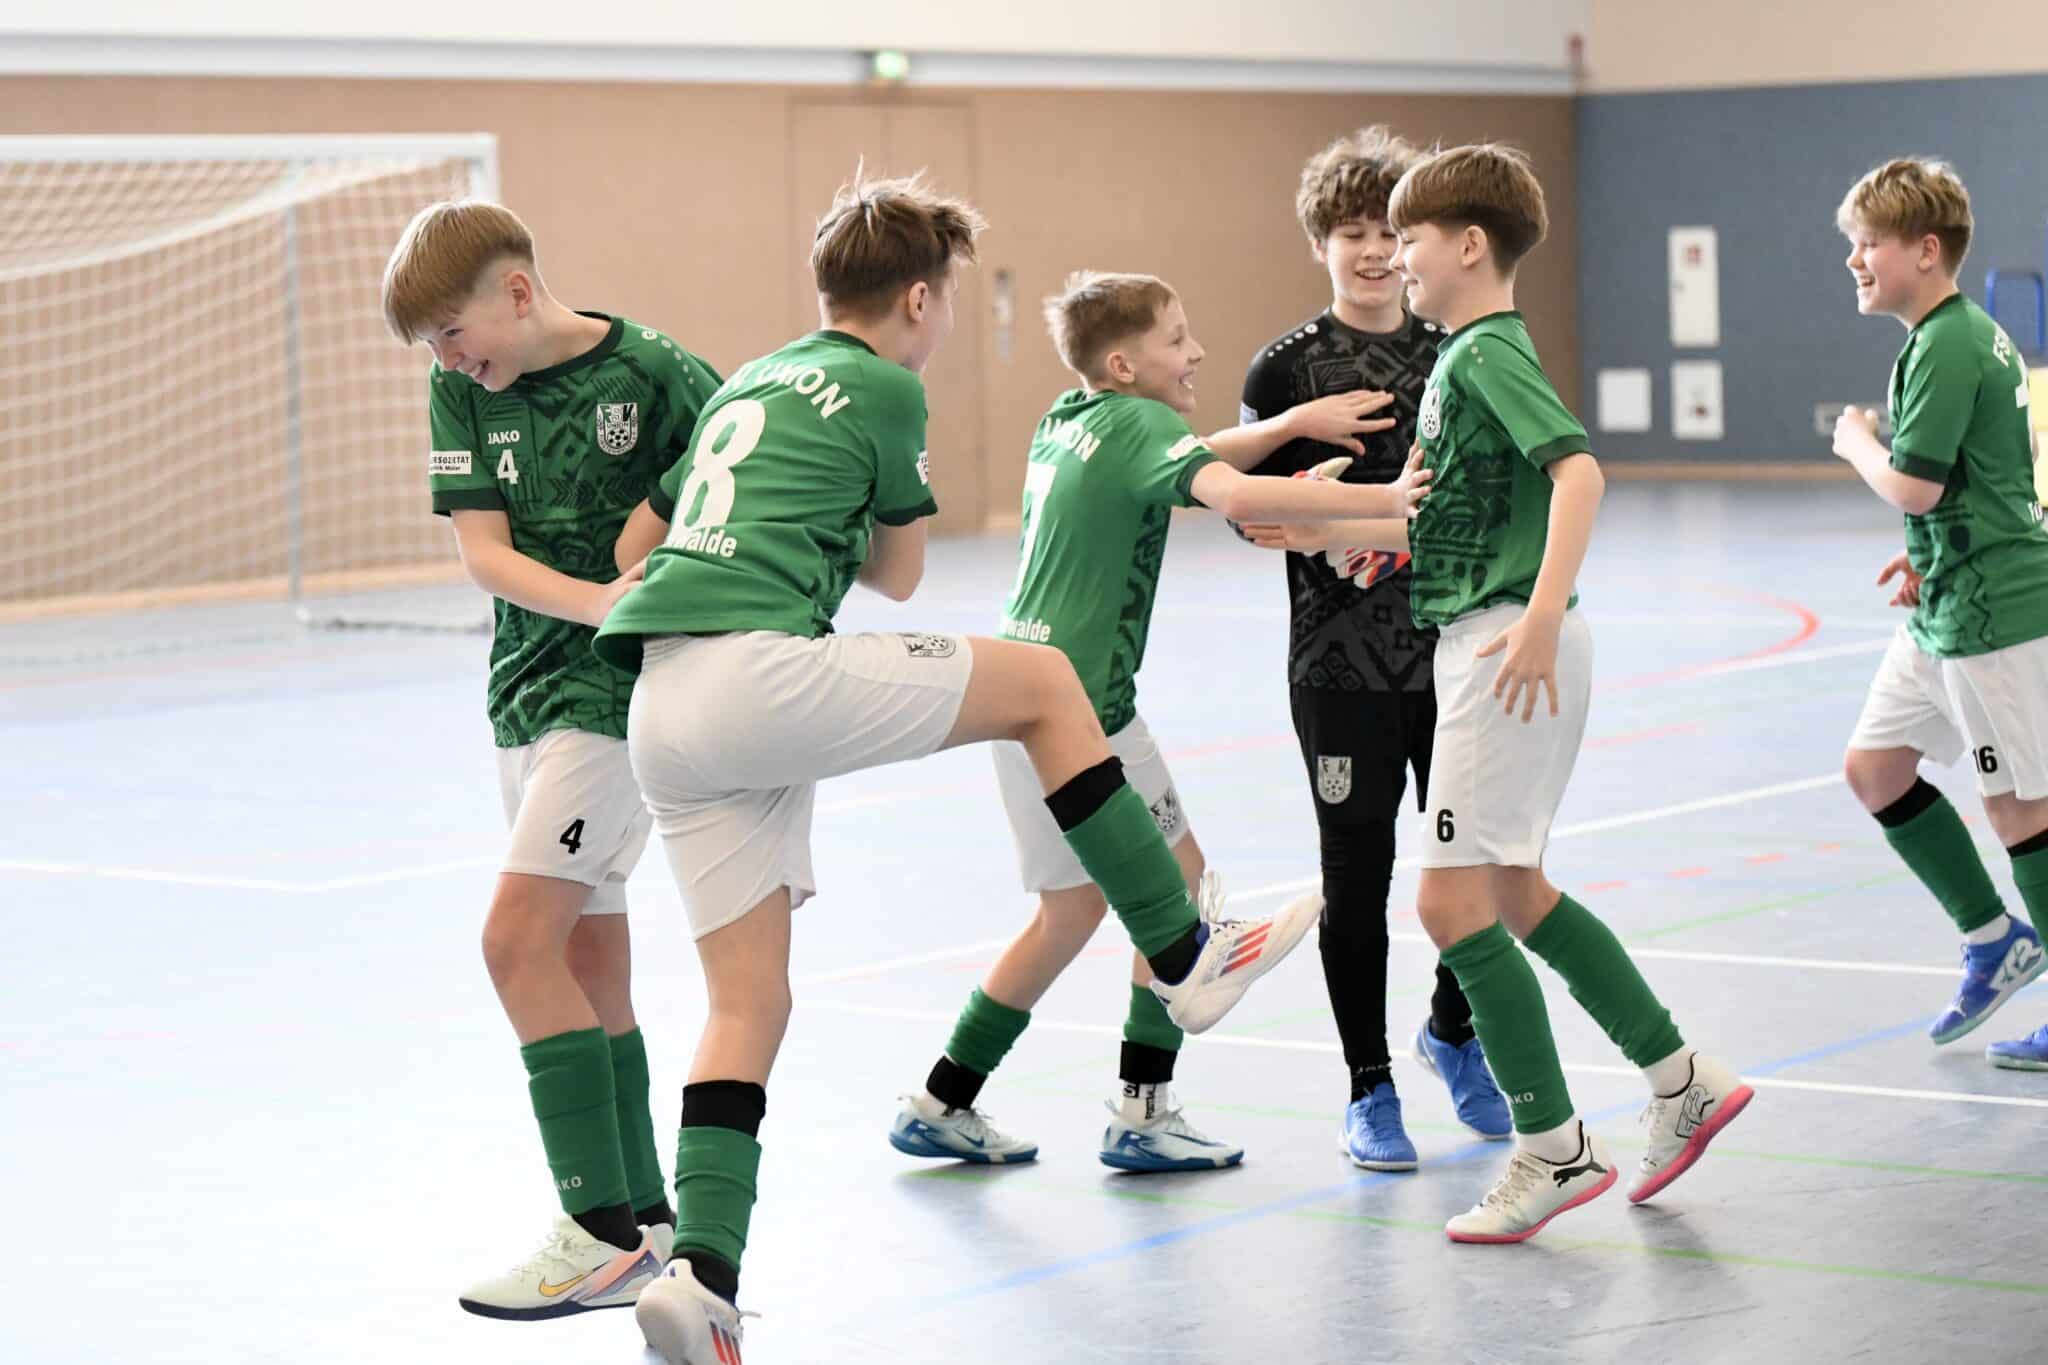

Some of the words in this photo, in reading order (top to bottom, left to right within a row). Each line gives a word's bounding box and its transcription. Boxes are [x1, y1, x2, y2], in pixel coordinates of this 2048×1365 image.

[487, 430, 520, 444] JAKO
[497, 448, 519, 485] 4
[671, 398, 766, 531] 8
[1972, 745, 1998, 774] 16
[560, 818, 585, 855] 4
[1437, 808, 1455, 843] 6
